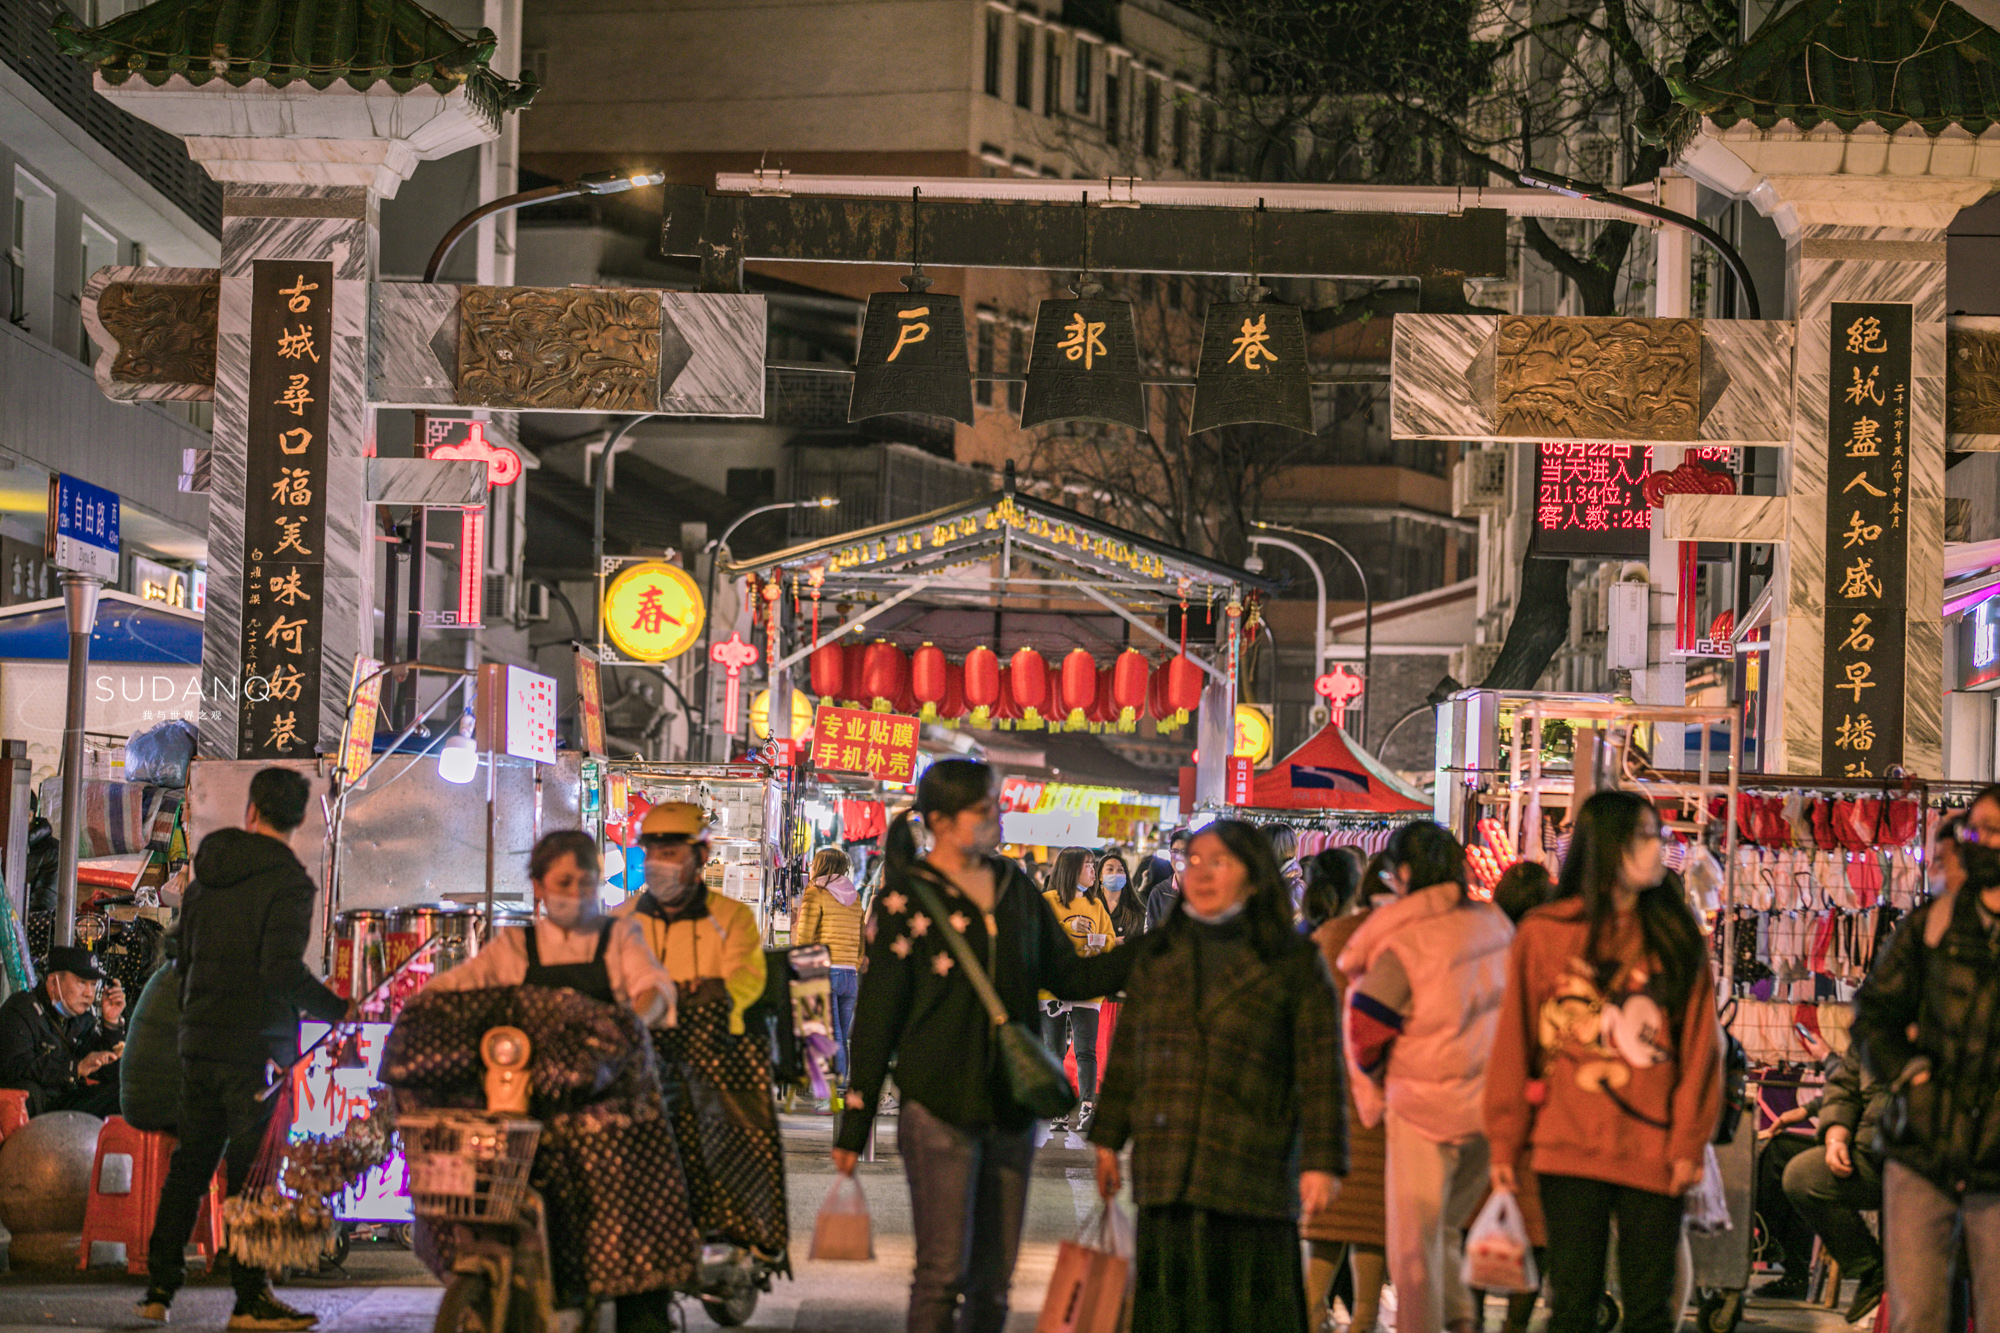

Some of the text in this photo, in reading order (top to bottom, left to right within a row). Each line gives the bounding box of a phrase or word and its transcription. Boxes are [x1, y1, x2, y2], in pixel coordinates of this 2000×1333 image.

[74, 491, 106, 538] 自由路
[630, 584, 682, 634] 春
[821, 713, 915, 749] 专业贴膜
[816, 742, 911, 777] 手机外壳
